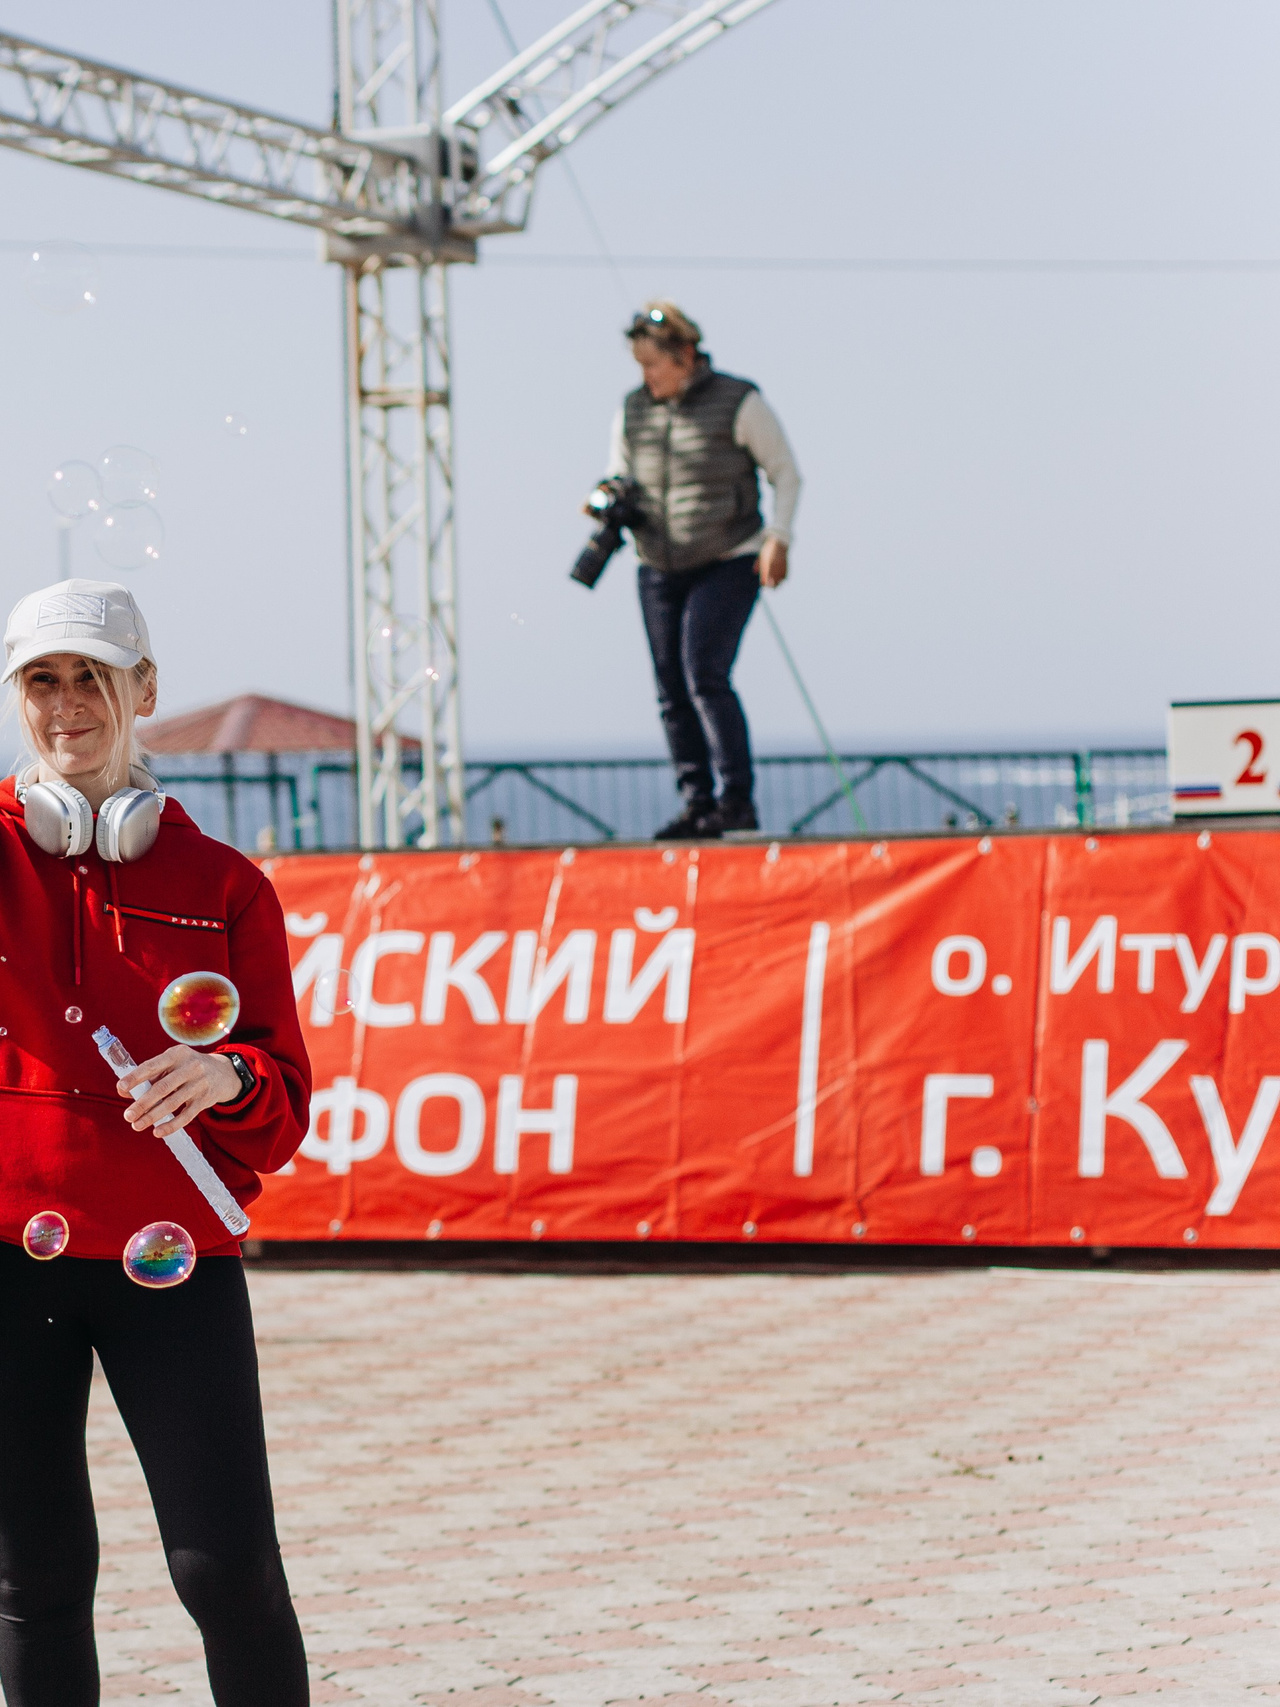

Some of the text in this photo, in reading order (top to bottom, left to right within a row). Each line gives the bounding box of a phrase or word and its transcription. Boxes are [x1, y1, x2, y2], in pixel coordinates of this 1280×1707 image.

[1233, 730, 1267, 785] 2
[171, 917, 219, 928] PRADA
[931, 934, 1013, 996] о.
[920, 1073, 1003, 1178] г.
